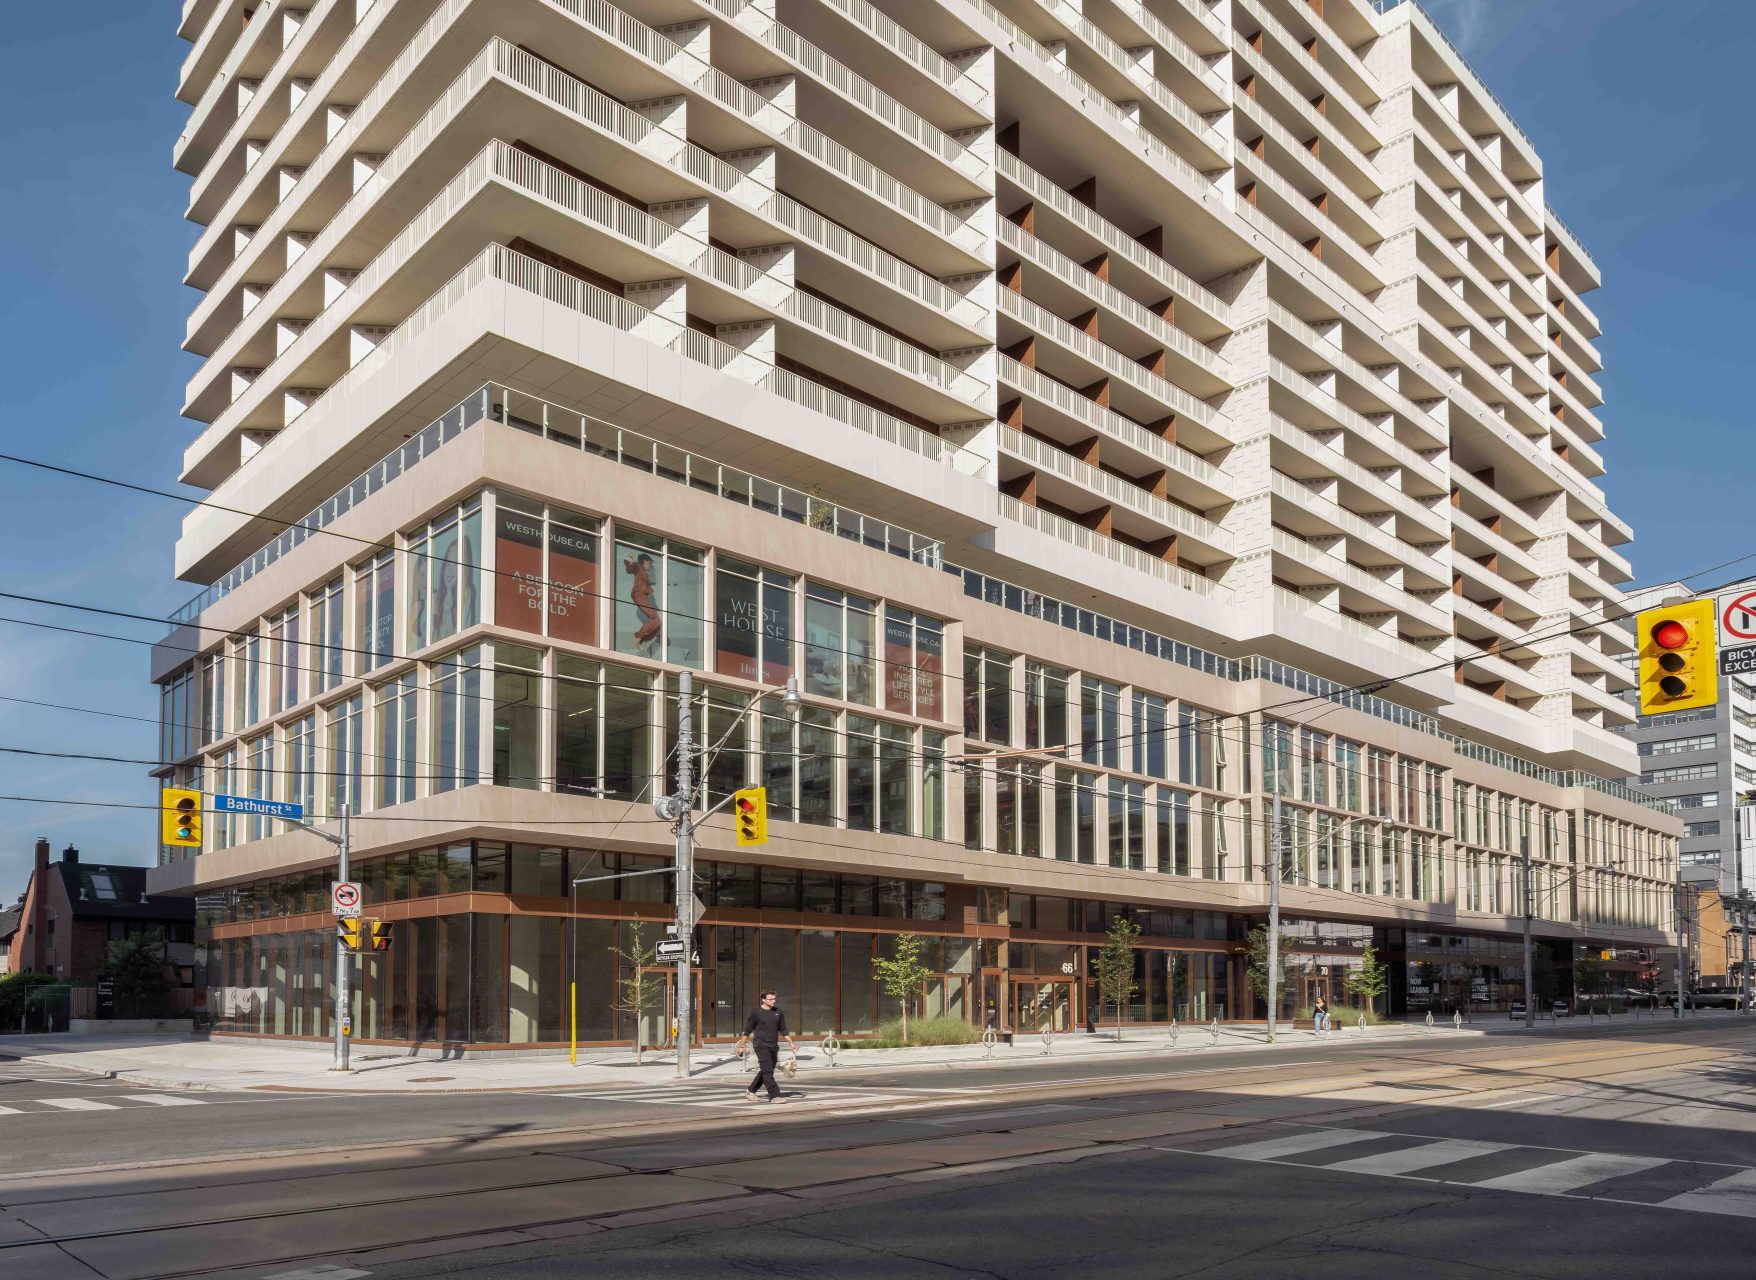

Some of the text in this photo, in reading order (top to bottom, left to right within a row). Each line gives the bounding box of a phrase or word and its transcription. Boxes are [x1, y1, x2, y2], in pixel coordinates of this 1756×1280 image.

[512, 570, 521, 581] A
[552, 592, 577, 607] THE
[731, 598, 779, 623] WEST
[887, 627, 940, 648] WESTHUSE.CA
[740, 662, 770, 679] Hins
[893, 671, 933, 687] INSPRED
[892, 689, 935, 706] SERVCES
[226, 797, 282, 815] Bathurst
[1062, 962, 1073, 974] 66
[1320, 966, 1329, 976] 70
